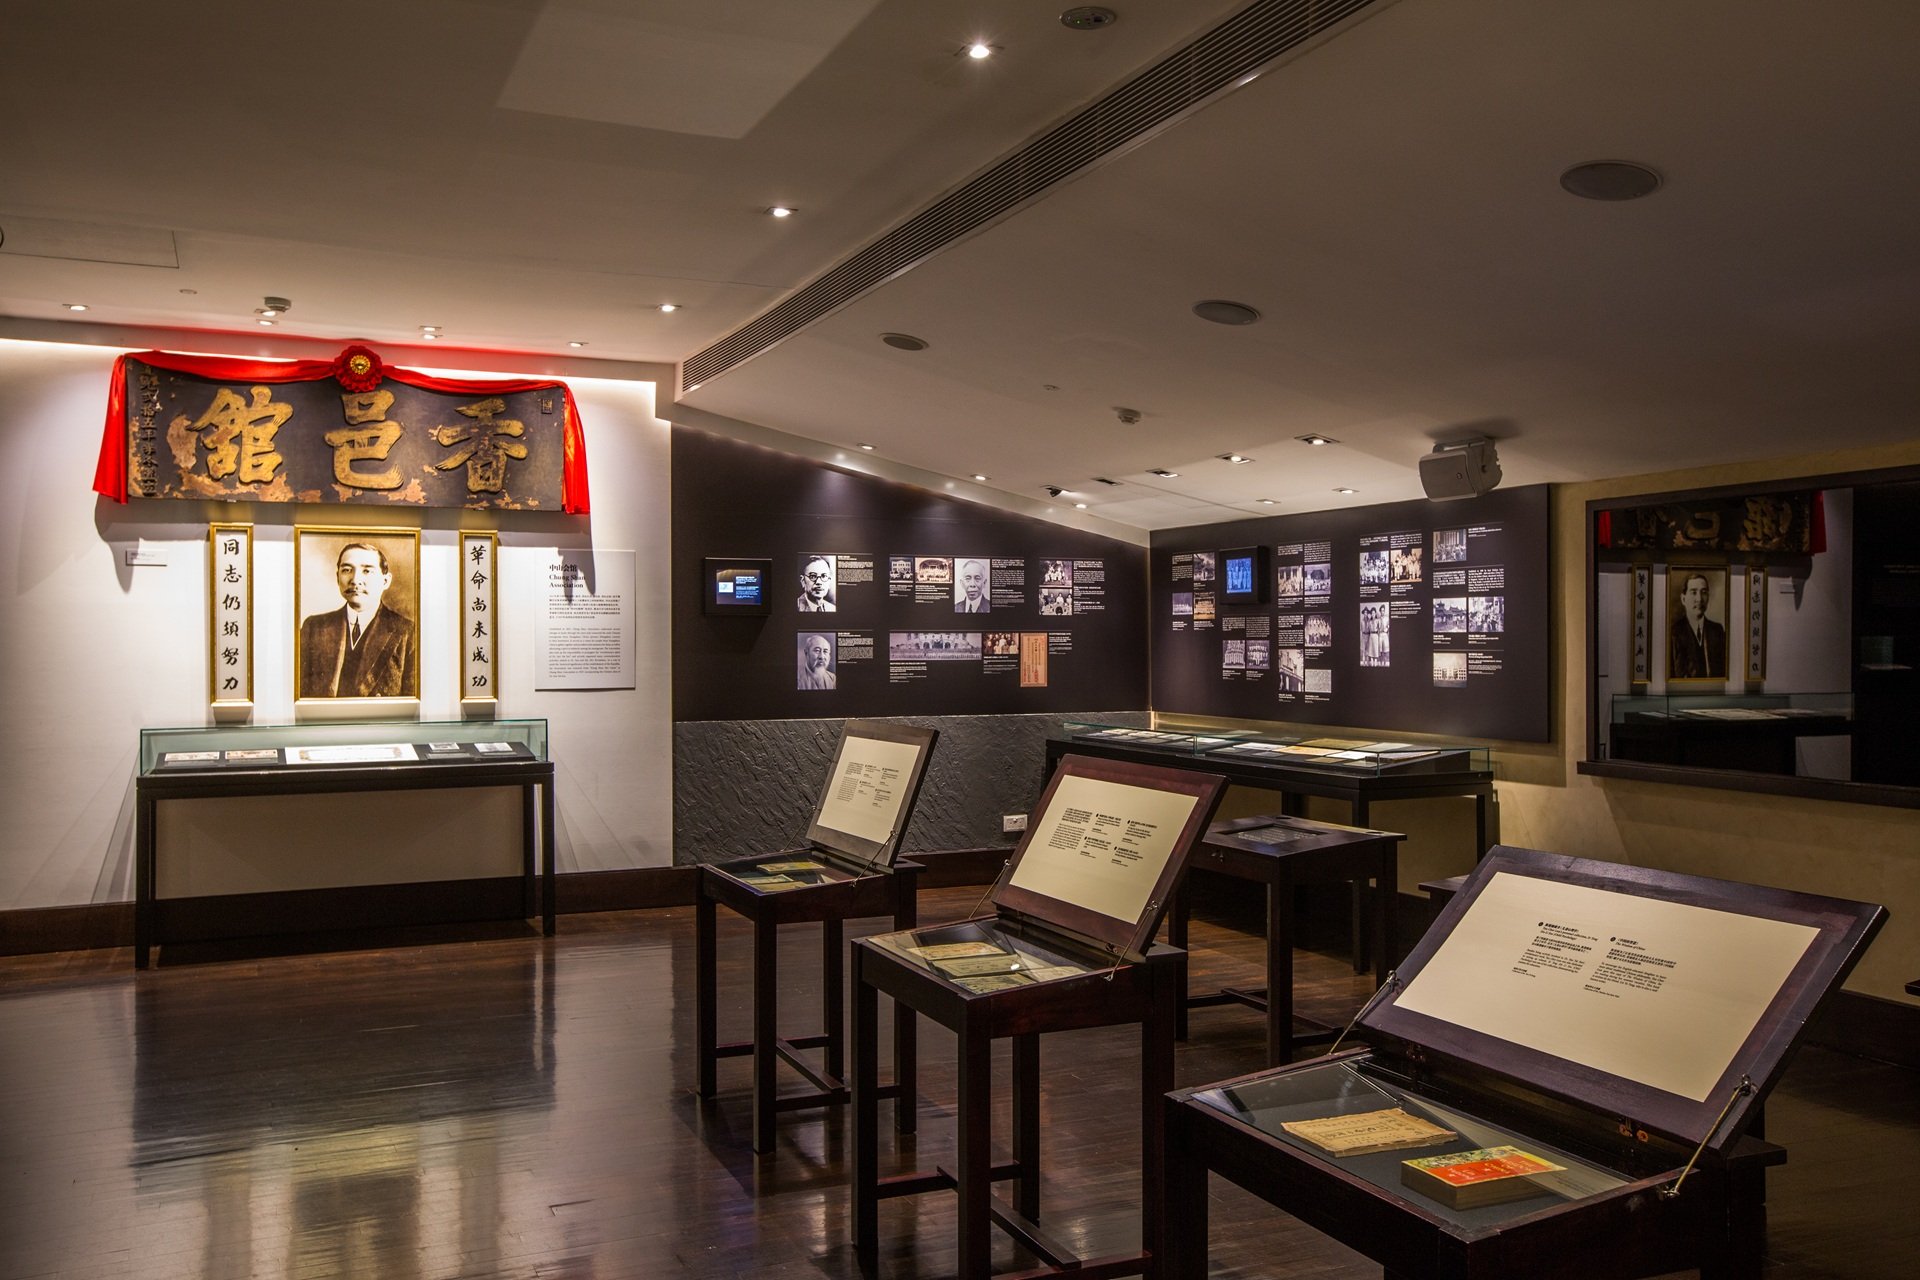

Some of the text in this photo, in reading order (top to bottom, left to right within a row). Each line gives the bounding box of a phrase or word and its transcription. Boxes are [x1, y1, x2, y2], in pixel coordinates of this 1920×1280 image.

[221, 539, 242, 690] 同志仍須努力
[470, 545, 489, 687] 革命尚未成功
